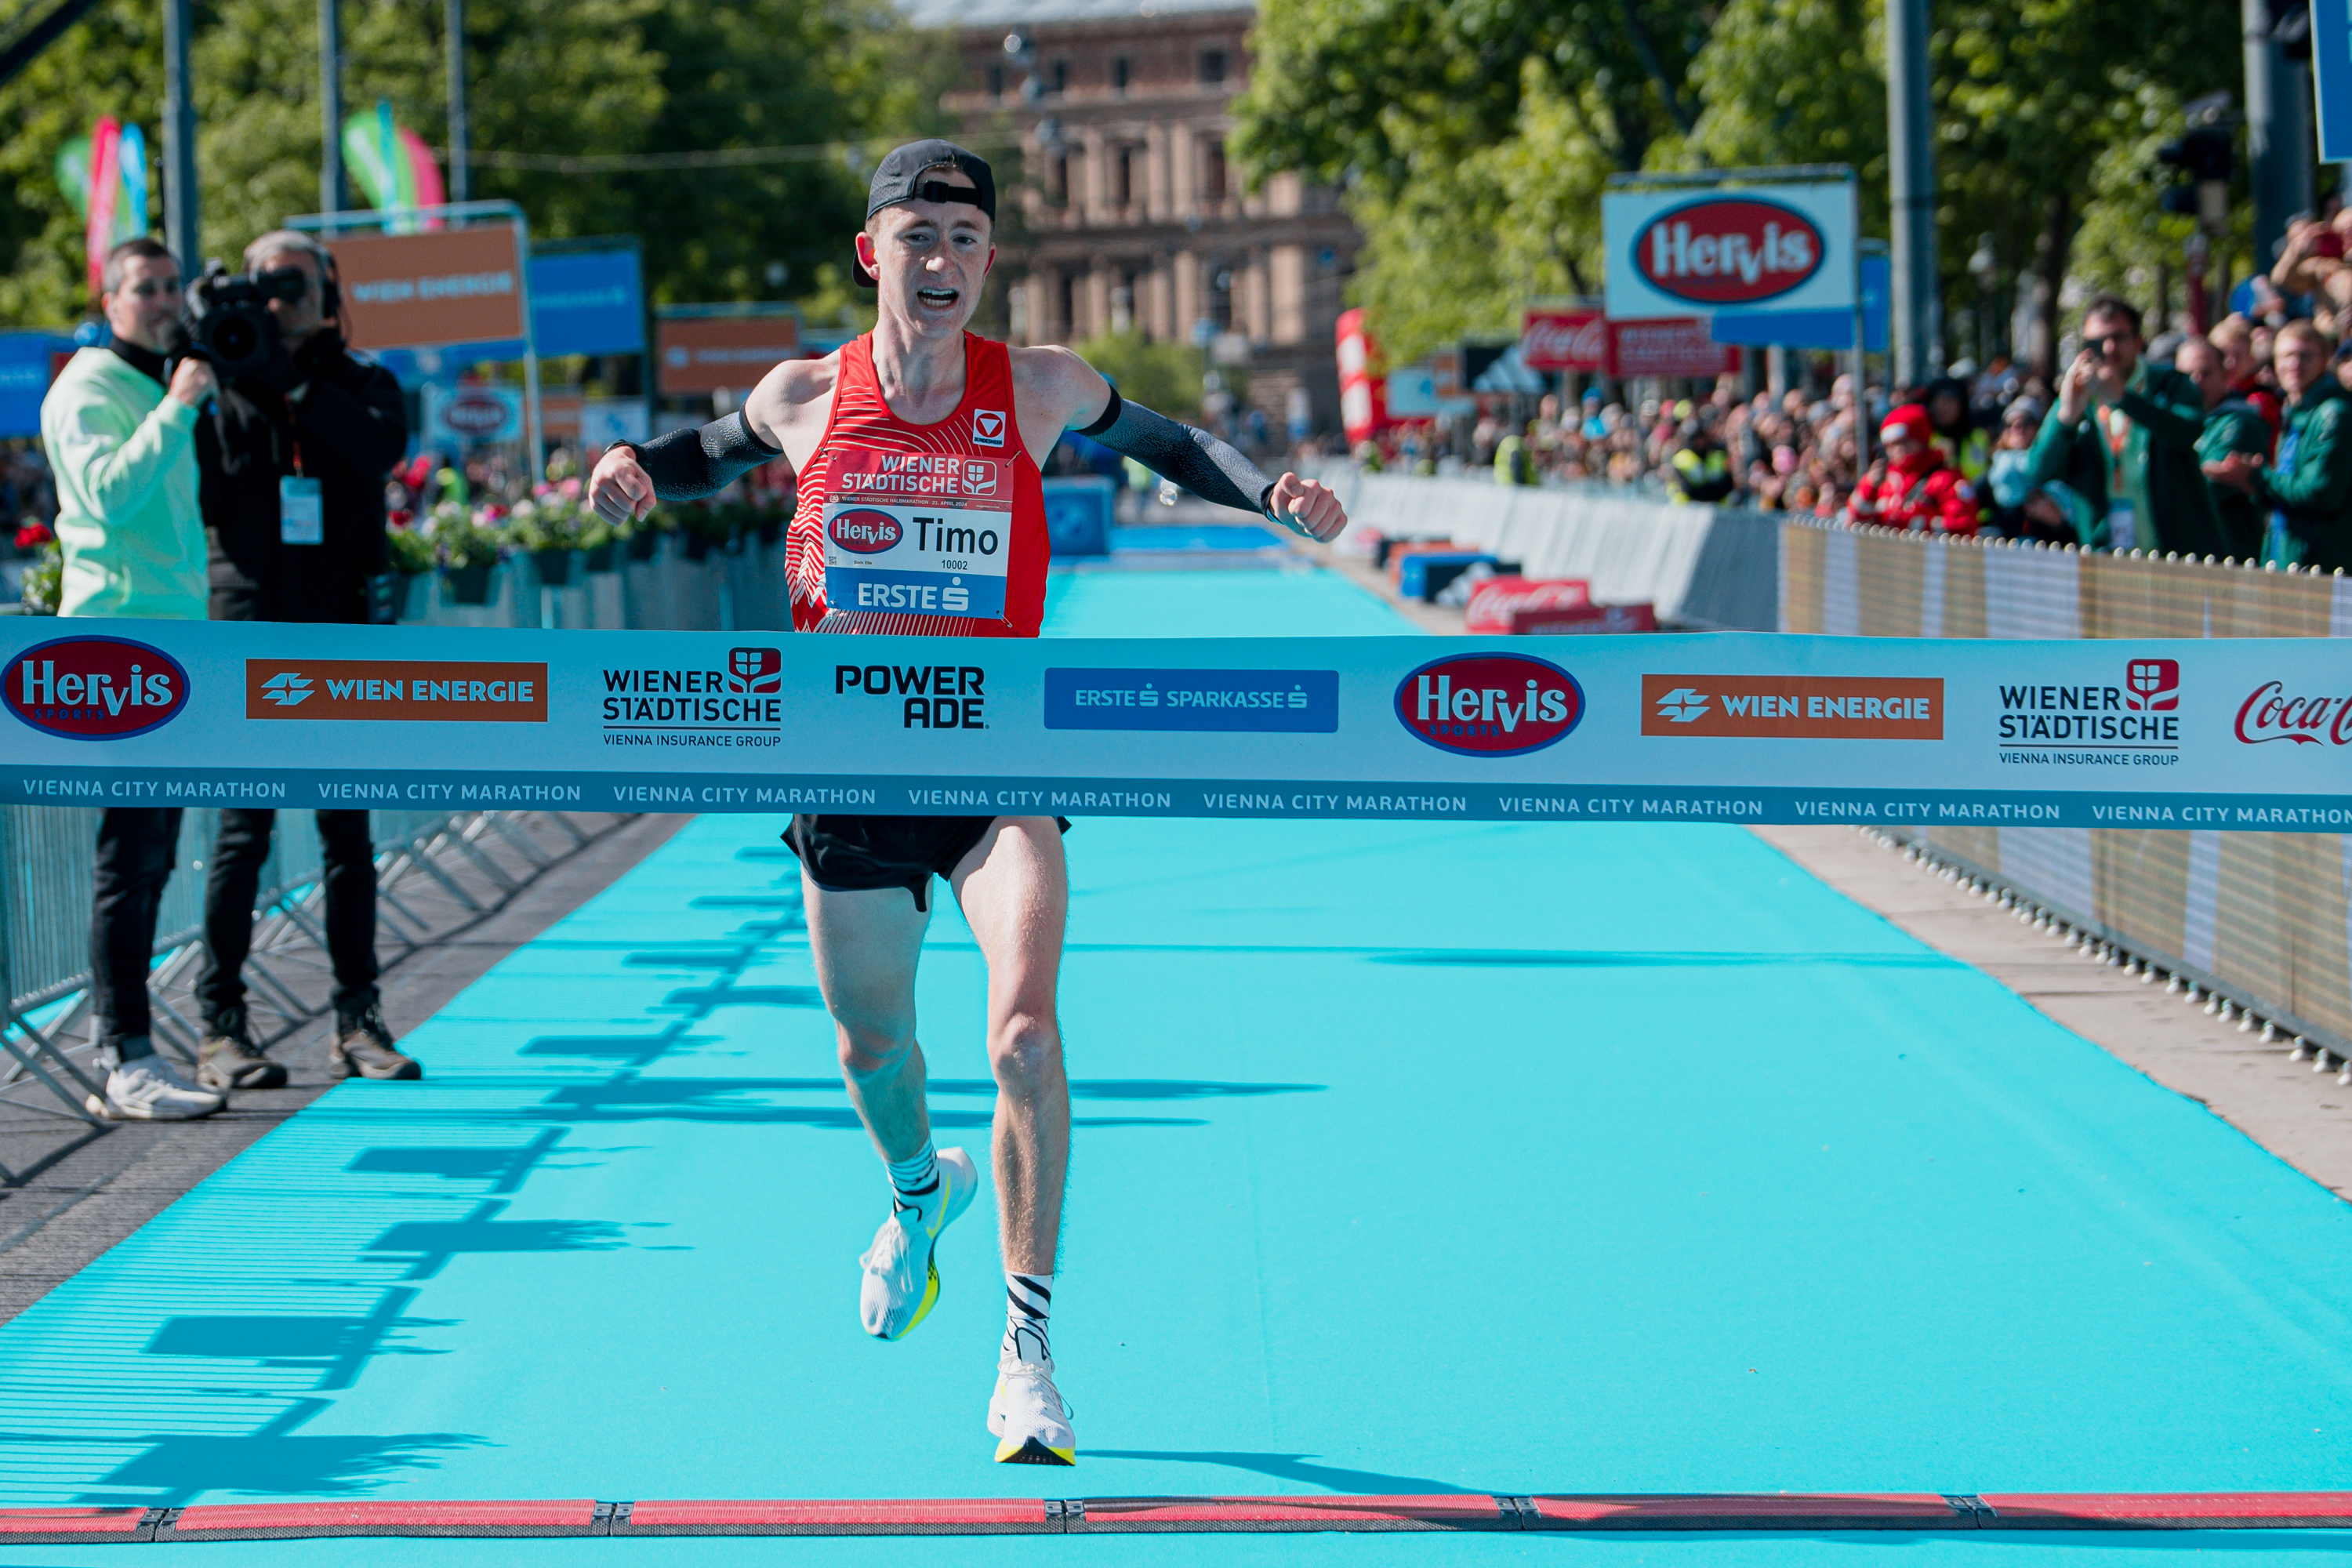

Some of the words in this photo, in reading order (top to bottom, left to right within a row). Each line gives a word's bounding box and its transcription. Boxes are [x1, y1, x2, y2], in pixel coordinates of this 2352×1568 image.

[1651, 220, 1812, 286] Hervis
[881, 455, 960, 475] WIENER
[841, 472, 958, 494] STÄDTISCHE
[837, 518, 896, 545] Hervis
[912, 516, 999, 555] Timo
[941, 560, 968, 570] 10002
[858, 583, 938, 610] ERSTE
[22, 659, 173, 717] Hervis
[325, 678, 404, 702] WIEN
[412, 680, 534, 702] ENERGIE
[602, 670, 724, 693] WIENER
[835, 665, 985, 696] POWER
[1076, 690, 1136, 706] ERSTE
[1166, 691, 1284, 709] SPARKASSE
[1417, 675, 1568, 732] Hervis
[1998, 684, 2121, 710] WIENER
[34, 709, 105, 721] SPORTS
[602, 697, 782, 722] STÄDTISCHE
[1720, 695, 1798, 718] WIEN
[1807, 696, 1930, 720] ENERGIE
[1429, 724, 1500, 736] SPORTS
[1998, 714, 2180, 740] STÄDTISCHE
[603, 734, 653, 746] VIENNA
[656, 735, 732, 747] INSURANCE
[736, 735, 782, 747] GROUP
[1999, 753, 2049, 764] VIENNA
[2053, 753, 2130, 766] INSURANCE
[2132, 754, 2179, 767] GROUP
[23, 779, 105, 797] VIENNA
[111, 780, 158, 797] CITY
[165, 781, 286, 799] MARATHON
[318, 782, 399, 800] VIENNA
[406, 784, 454, 800] CITY
[460, 785, 582, 801] MARATHON
[613, 786, 695, 802] VIENNA
[702, 786, 749, 803] CITY
[756, 787, 876, 804] MARATHON
[908, 789, 989, 806] VIENNA
[996, 790, 1044, 807] CITY
[1051, 791, 1171, 808] MARATHON
[1203, 793, 1284, 810] VIENNA
[1291, 794, 1339, 811] CITY
[1346, 795, 1467, 812] MARATHON
[1499, 797, 1581, 813] VIENNA
[1588, 798, 1635, 814] CITY
[1642, 799, 1763, 816] MARATHON
[1795, 801, 1877, 817] VIENNA
[1884, 802, 1932, 818] CITY
[1939, 803, 2060, 819] MARATHON
[2092, 805, 2175, 821] VIENNA
[2182, 806, 2230, 822] CITY
